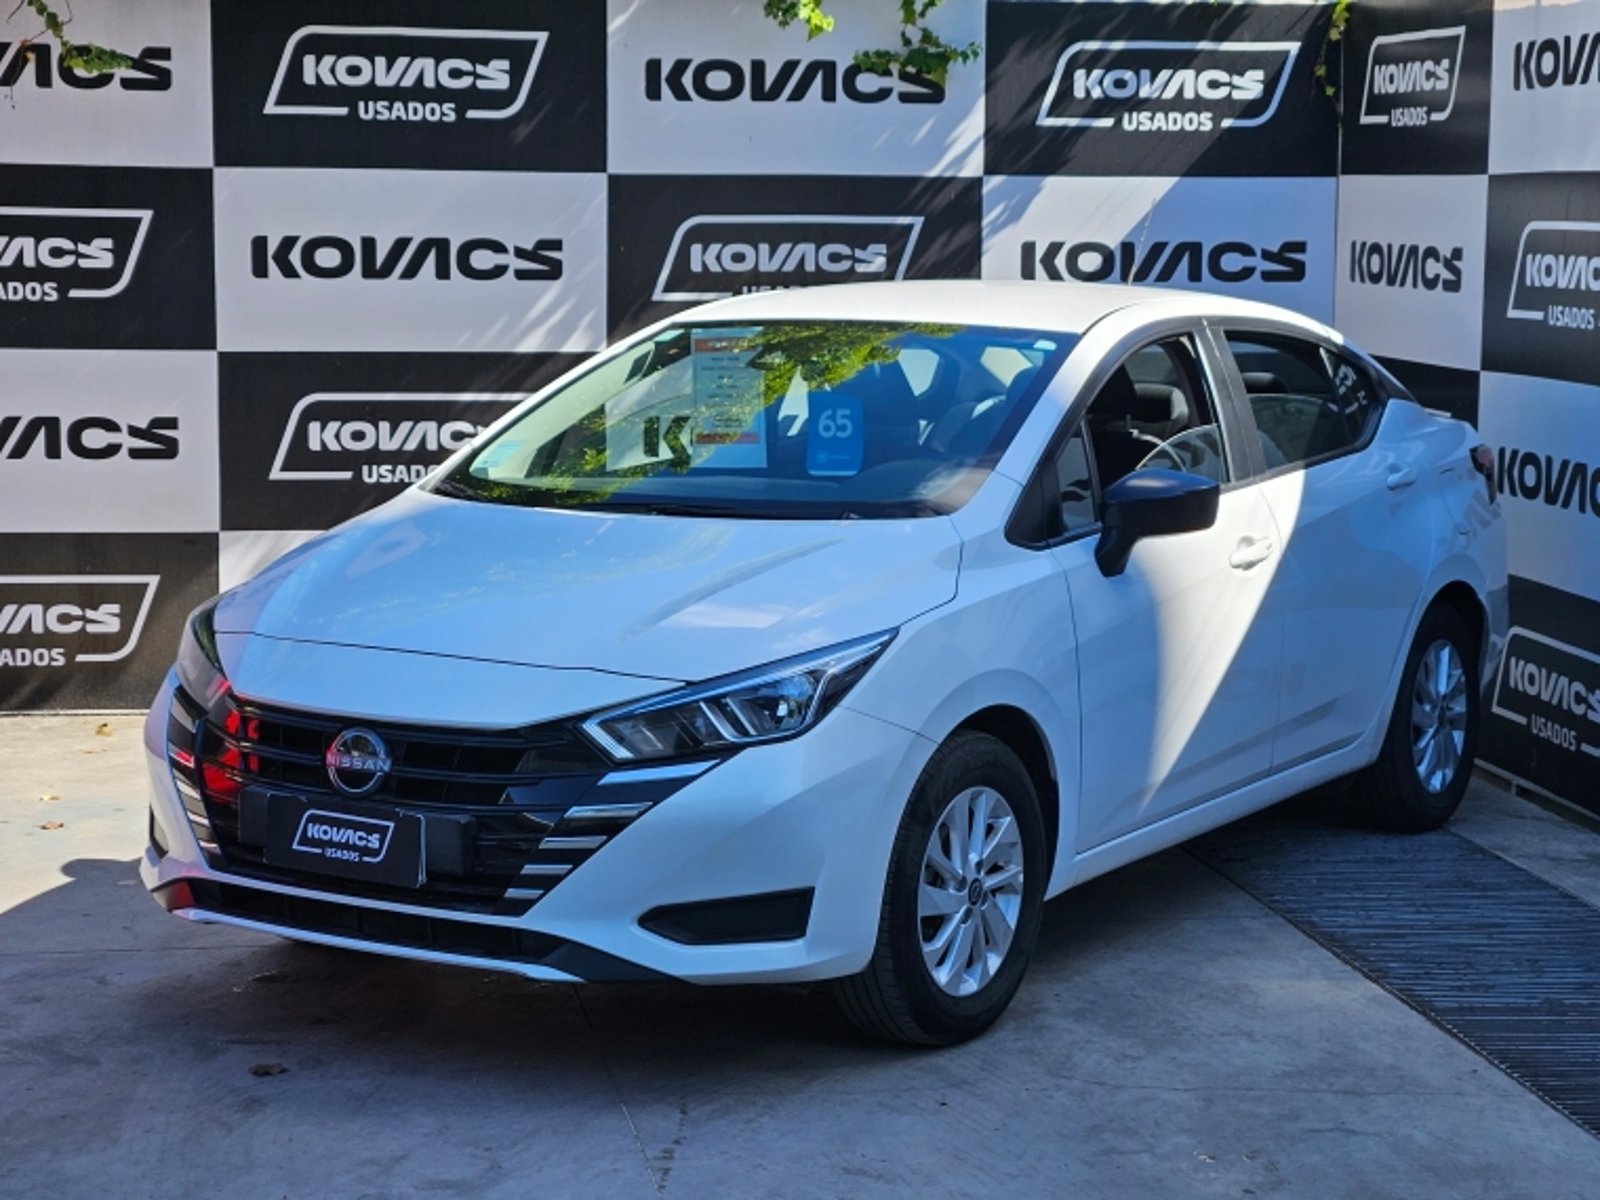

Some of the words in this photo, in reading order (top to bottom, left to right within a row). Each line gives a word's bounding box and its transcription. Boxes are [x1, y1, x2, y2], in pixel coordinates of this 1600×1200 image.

[0, 42, 172, 91] ACS
[302, 54, 511, 90] KOVACS
[645, 58, 946, 104] KOVACS
[1373, 57, 1450, 95] KOVACS
[1072, 68, 1264, 101] KOVACS
[358, 101, 456, 122] USADOS
[1122, 112, 1213, 132] USADOS
[1390, 106, 1429, 128] USADOS
[0, 235, 114, 268] ACS
[250, 235, 564, 281] KOVACS
[690, 242, 888, 273] KOVACS
[1020, 240, 1308, 283] KOVACS
[1350, 240, 1463, 293] KOVACS
[1547, 304, 1595, 330] USADOS
[307, 420, 488, 452] KOVAC
[818, 408, 853, 439] 65
[1531, 713, 1577, 752] USADOS
[326, 753, 390, 772] NISSAN
[307, 823, 380, 849] KOVACS
[324, 847, 360, 861] USADOS
